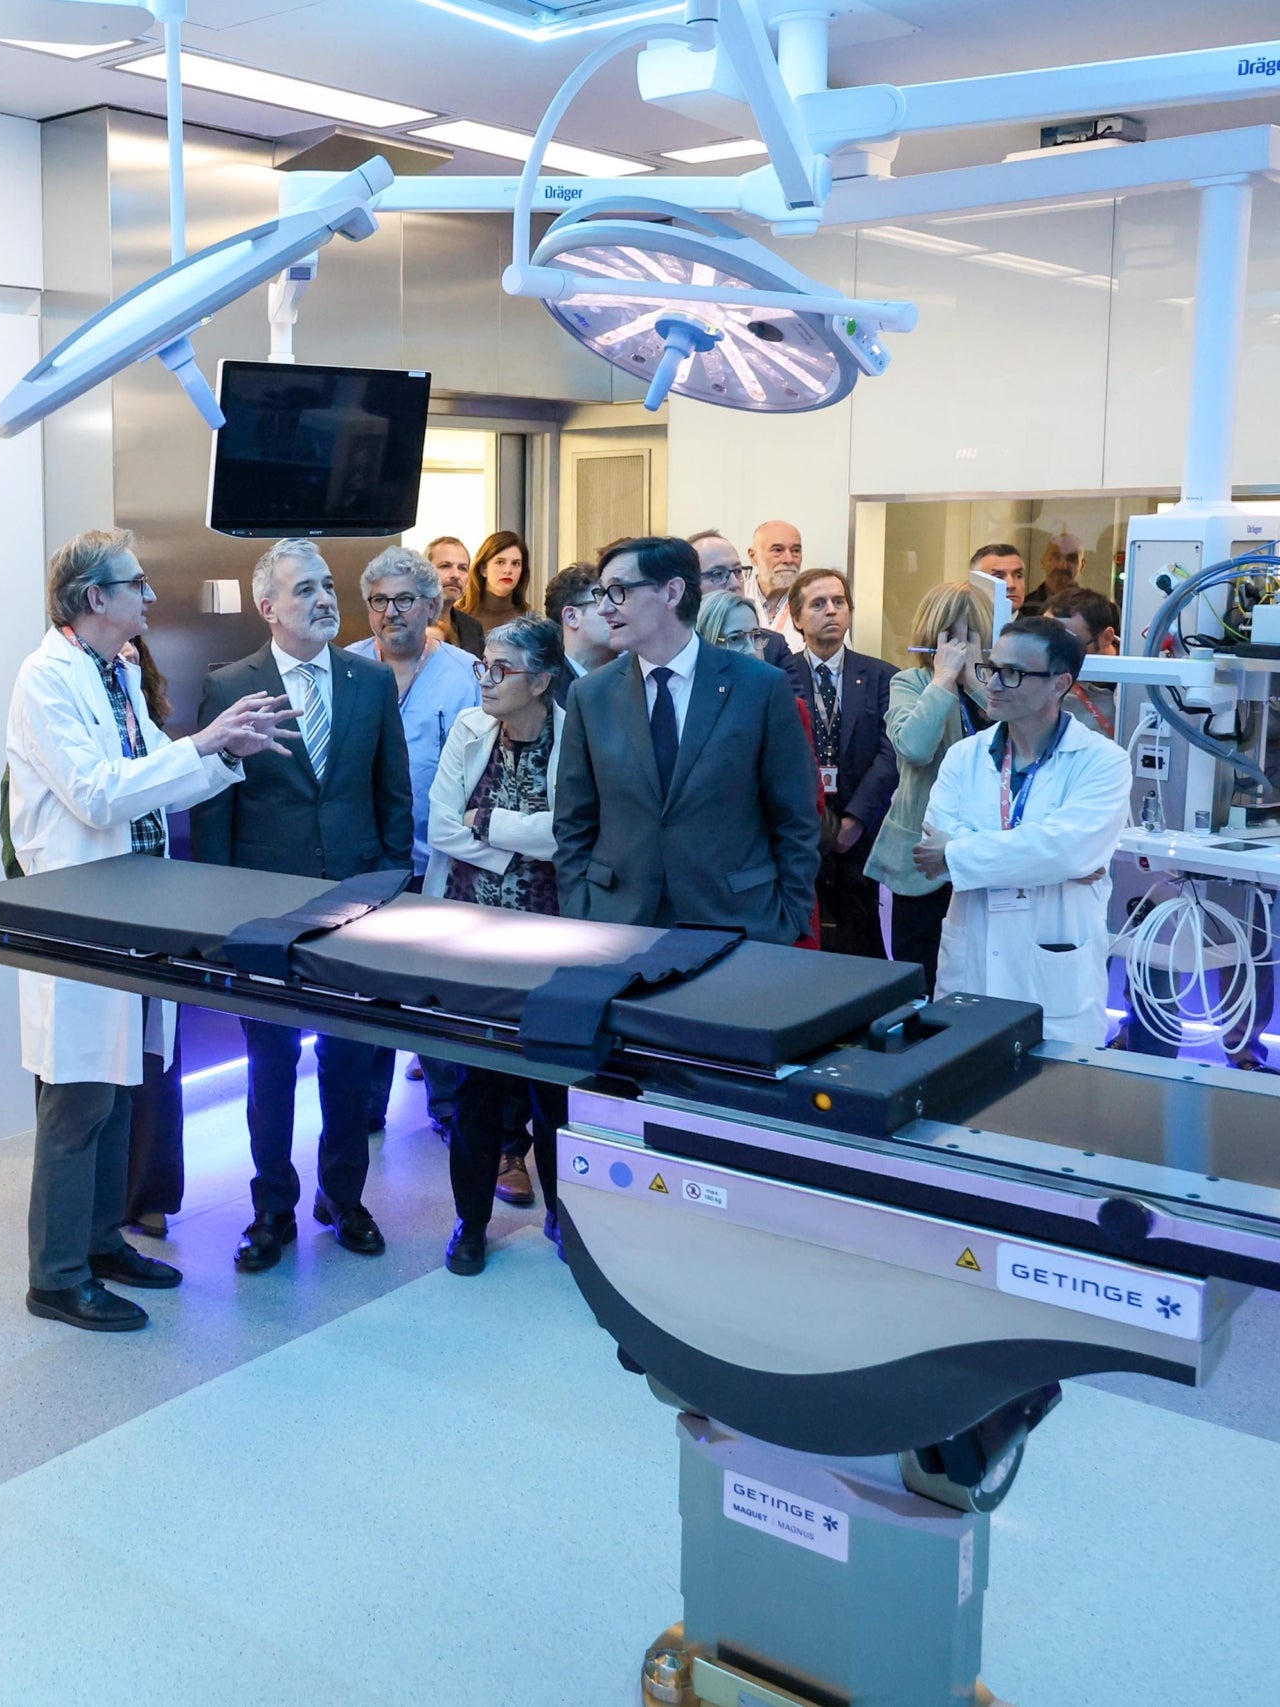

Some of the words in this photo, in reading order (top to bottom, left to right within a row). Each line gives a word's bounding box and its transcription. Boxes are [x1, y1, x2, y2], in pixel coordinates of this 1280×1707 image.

[544, 185, 584, 202] Dräger
[1011, 1263, 1144, 1309] GETINGE
[732, 1503, 769, 1523] MAQUET
[777, 1520, 816, 1541] MAGNUS
[733, 1483, 816, 1523] GETINGE
